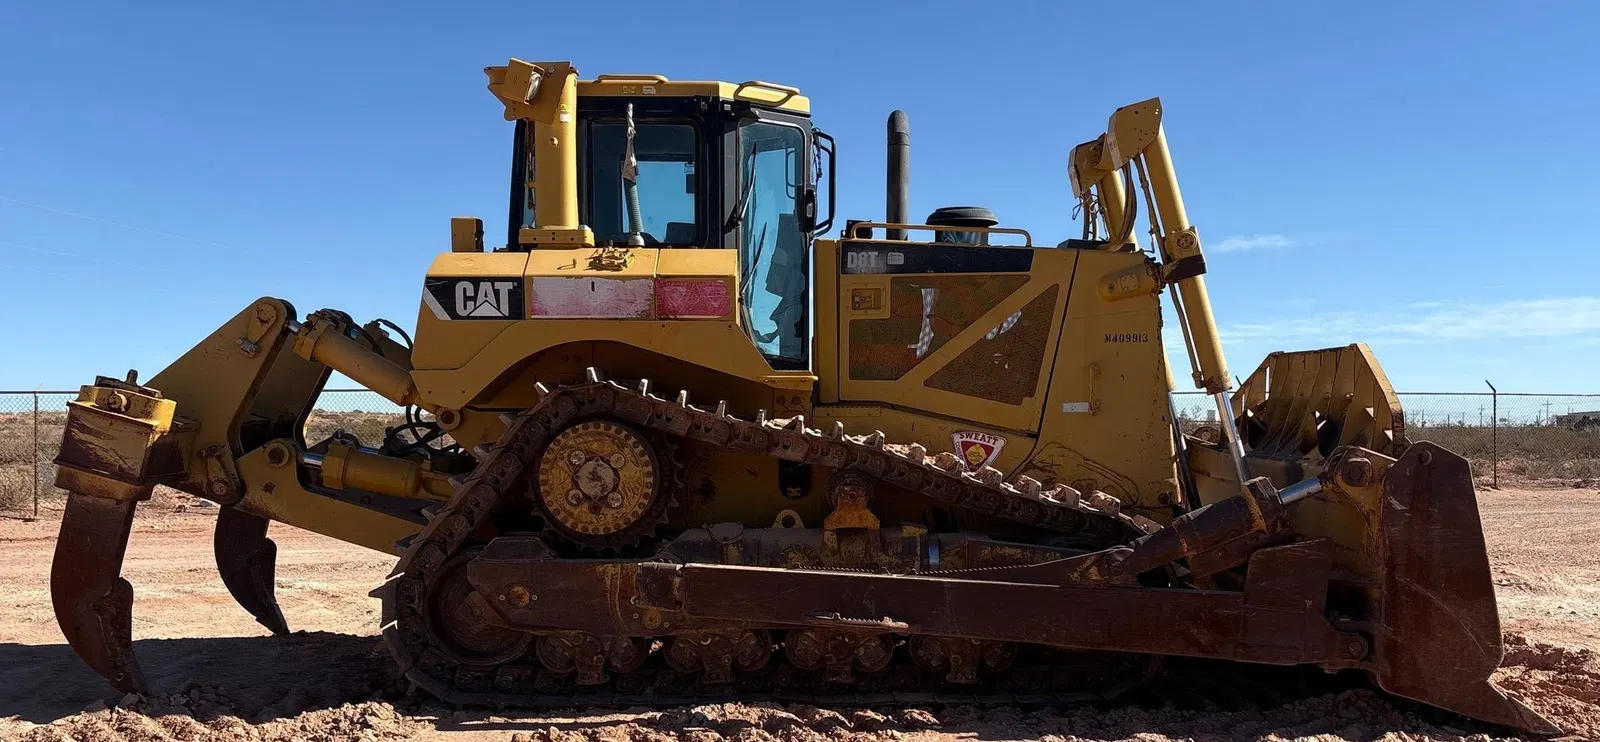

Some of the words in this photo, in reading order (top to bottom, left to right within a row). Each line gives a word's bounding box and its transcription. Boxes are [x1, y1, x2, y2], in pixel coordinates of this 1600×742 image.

[847, 251, 879, 268] D8T
[455, 281, 514, 317] CAT
[1104, 333, 1149, 343] M409913
[959, 432, 999, 445] SWEATT
